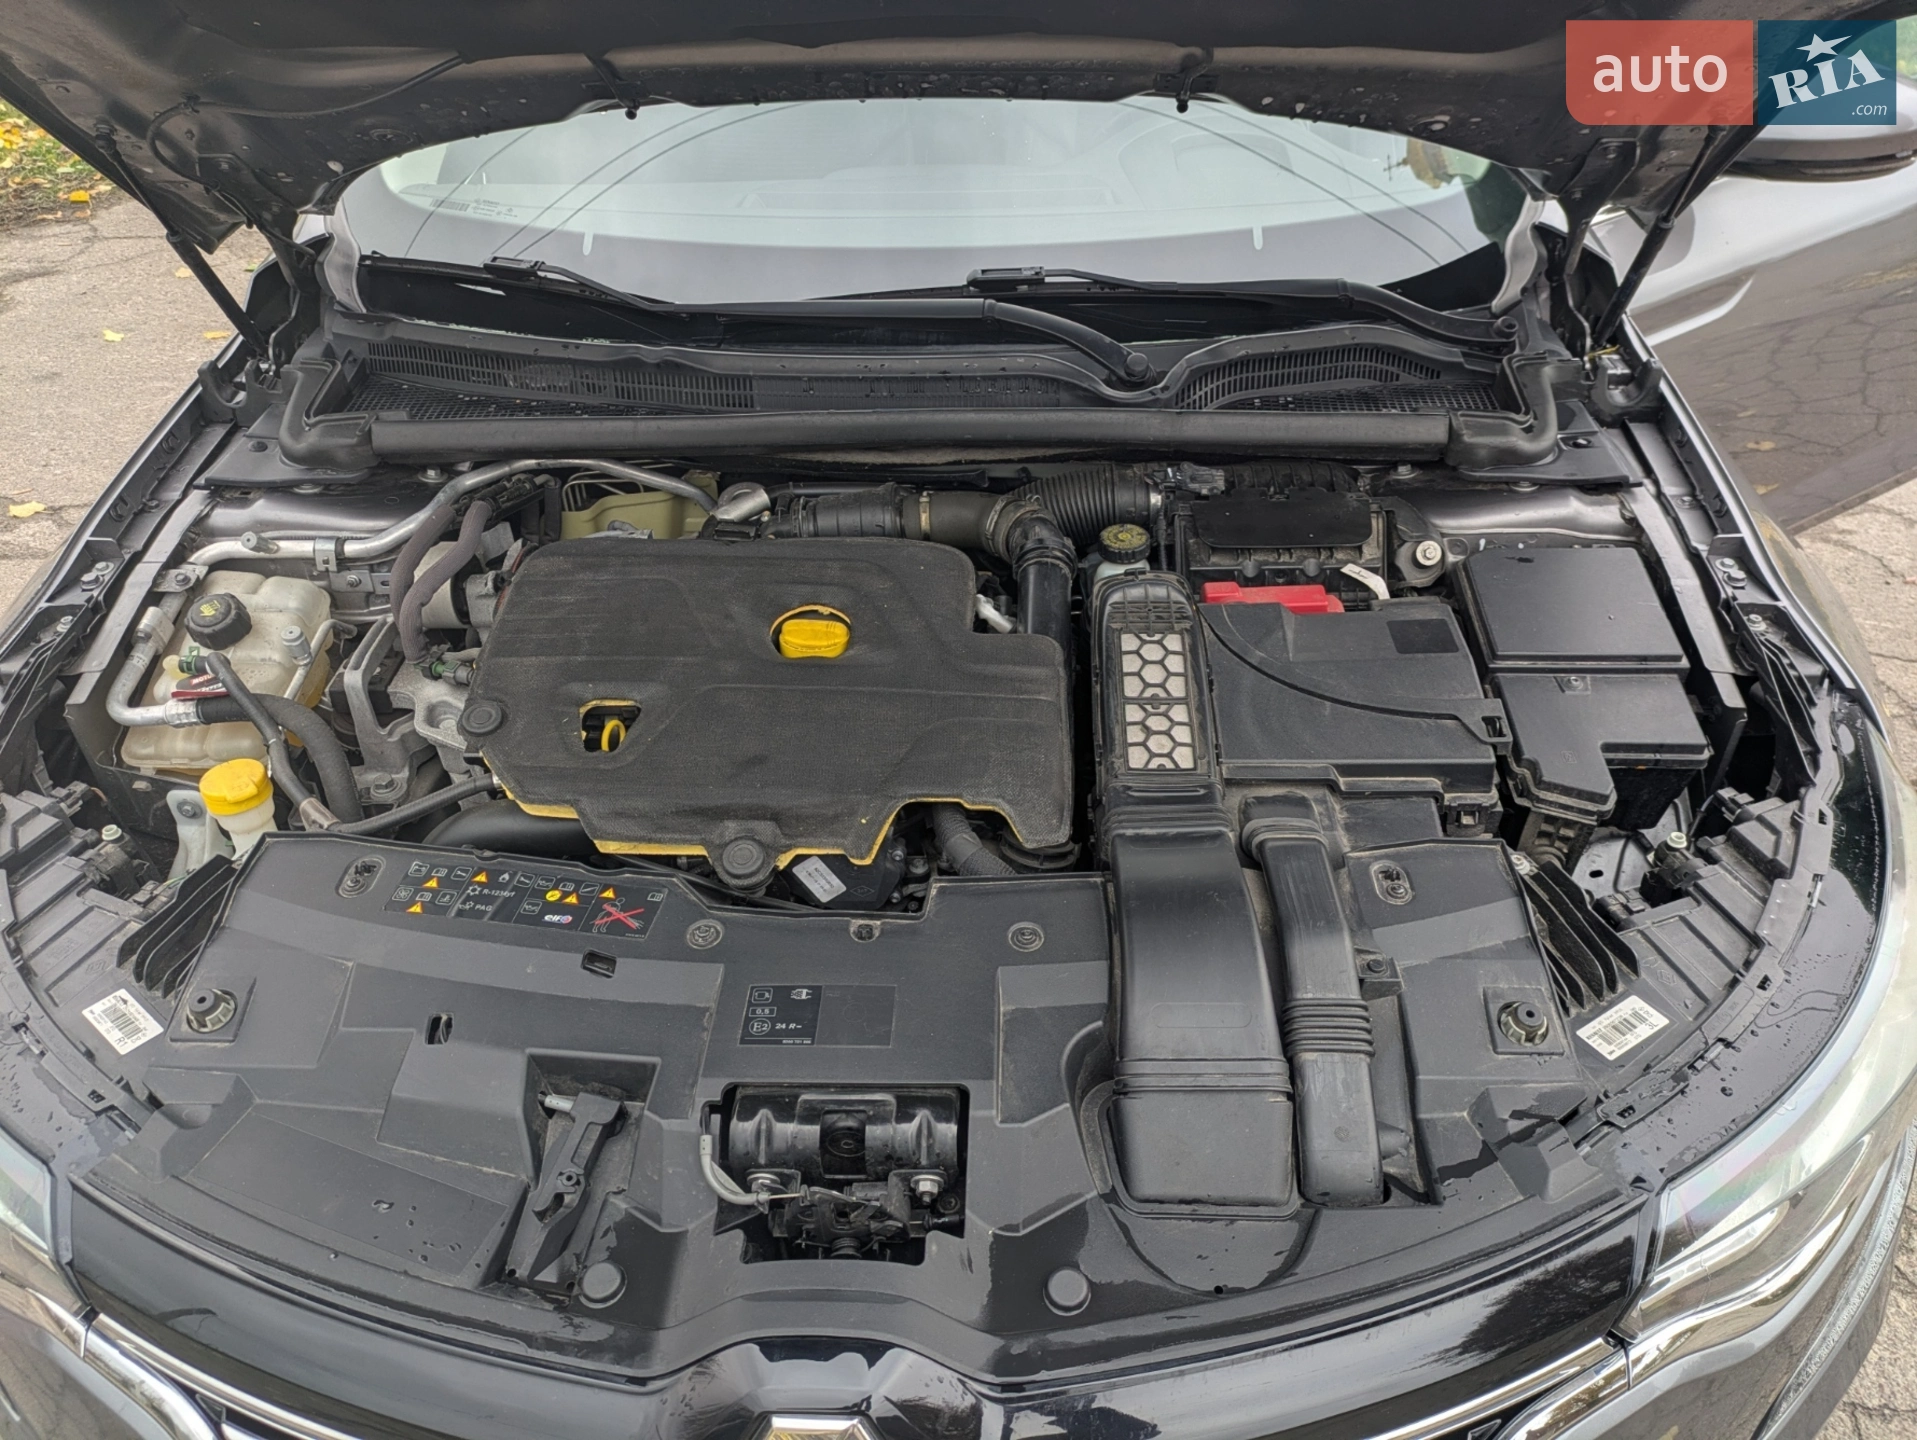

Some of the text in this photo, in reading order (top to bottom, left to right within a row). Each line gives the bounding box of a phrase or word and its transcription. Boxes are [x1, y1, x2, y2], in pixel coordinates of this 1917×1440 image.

[191, 674, 217, 686] MOTU
[474, 904, 493, 912] PAG
[752, 1021, 769, 1032] E2
